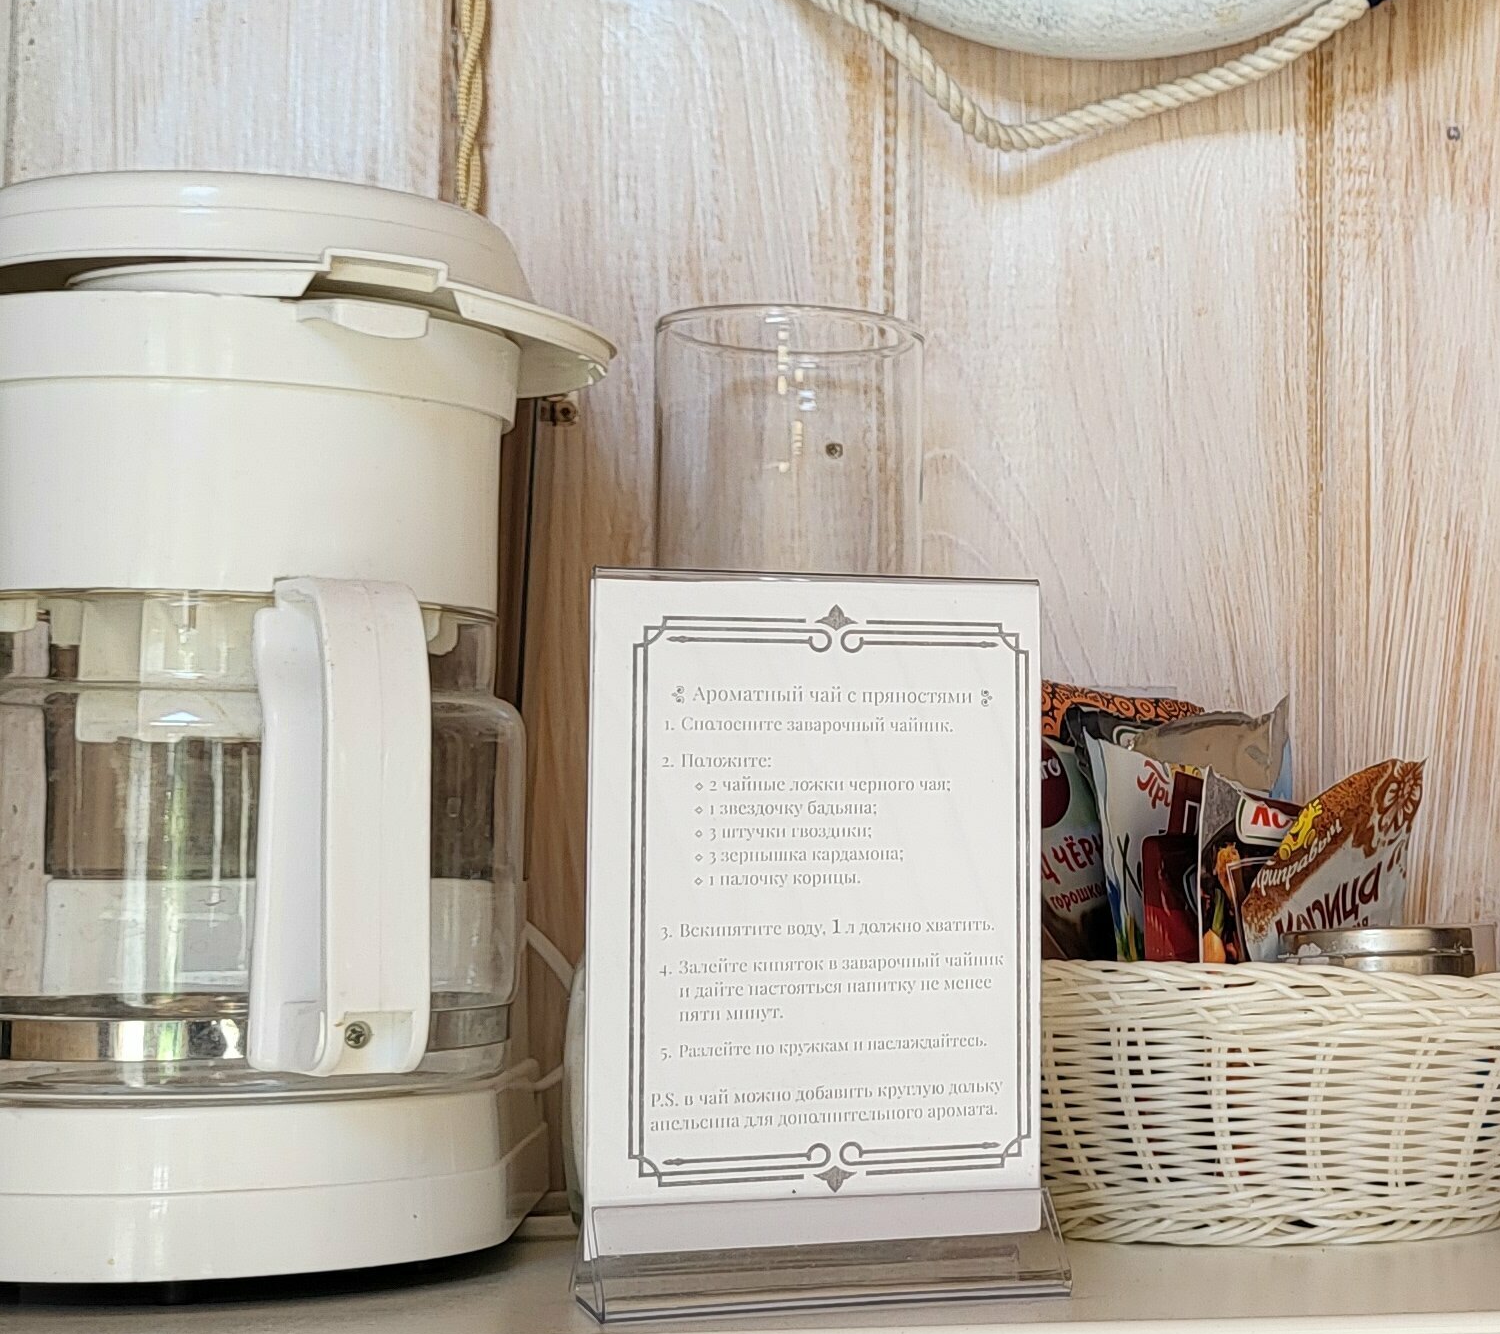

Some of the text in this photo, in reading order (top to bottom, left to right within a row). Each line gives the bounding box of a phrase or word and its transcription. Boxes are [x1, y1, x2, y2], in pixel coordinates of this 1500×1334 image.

[692, 685, 972, 707] Ароматный чай с пряностями
[664, 717, 953, 734] 1. Сполосните заварочный чайник.
[662, 754, 772, 769] 2. Положите:
[709, 776, 951, 794] 2 чайные ложки черного чая;
[719, 803, 803, 817] звездочку
[807, 800, 877, 817] бадьяна;
[709, 826, 872, 841] 3 штучки гвоздики;
[709, 848, 904, 865] 3 зернышка кардамона;
[720, 874, 788, 888] палочку
[792, 873, 861, 887] корицы.
[660, 919, 995, 941] 3. Вскипятите воду, 1 л должно хватить.
[679, 958, 748, 974] Залейте
[752, 958, 824, 972] кипяток
[828, 959, 838, 970] в
[841, 952, 940, 971] заварочный
[945, 952, 1004, 967] чайник
[679, 977, 992, 998] и дайте настояться напитку не менее
[679, 1006, 784, 1022] пяти минут.
[660, 1033, 987, 1060] 5. Разлейте по кружкам и наслаждайтесь.
[684, 1095, 694, 1106] в
[699, 1089, 729, 1105] чай
[734, 1091, 791, 1105] можно
[795, 1085, 873, 1102] добавить
[877, 1083, 945, 1100] круглую
[949, 1080, 1004, 1097] дольку
[650, 1103, 998, 1132] апельсина для дополнительного аромата.
